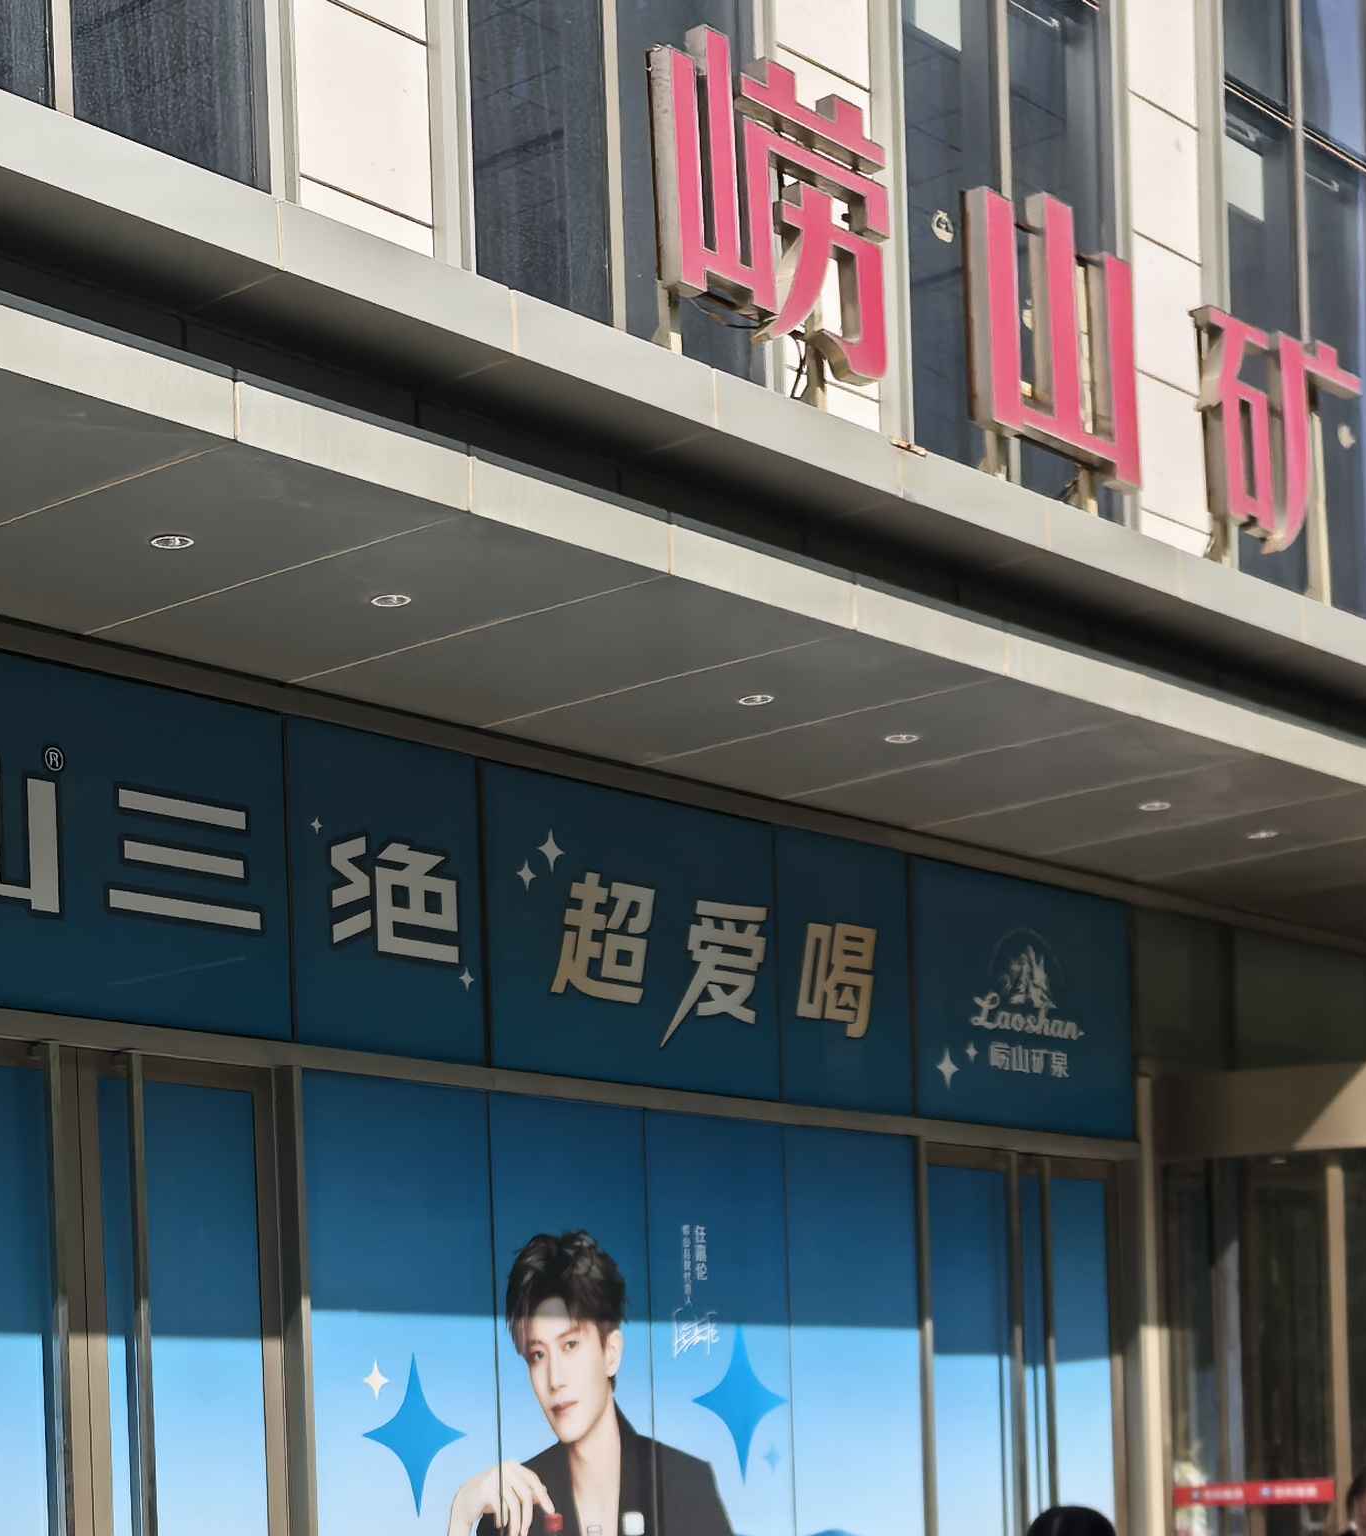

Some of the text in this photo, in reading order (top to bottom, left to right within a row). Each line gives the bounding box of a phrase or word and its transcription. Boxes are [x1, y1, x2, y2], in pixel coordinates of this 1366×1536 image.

[971, 992, 1085, 1041] Laoshan
[989, 1040, 1069, 1078] 崂山矿泉
